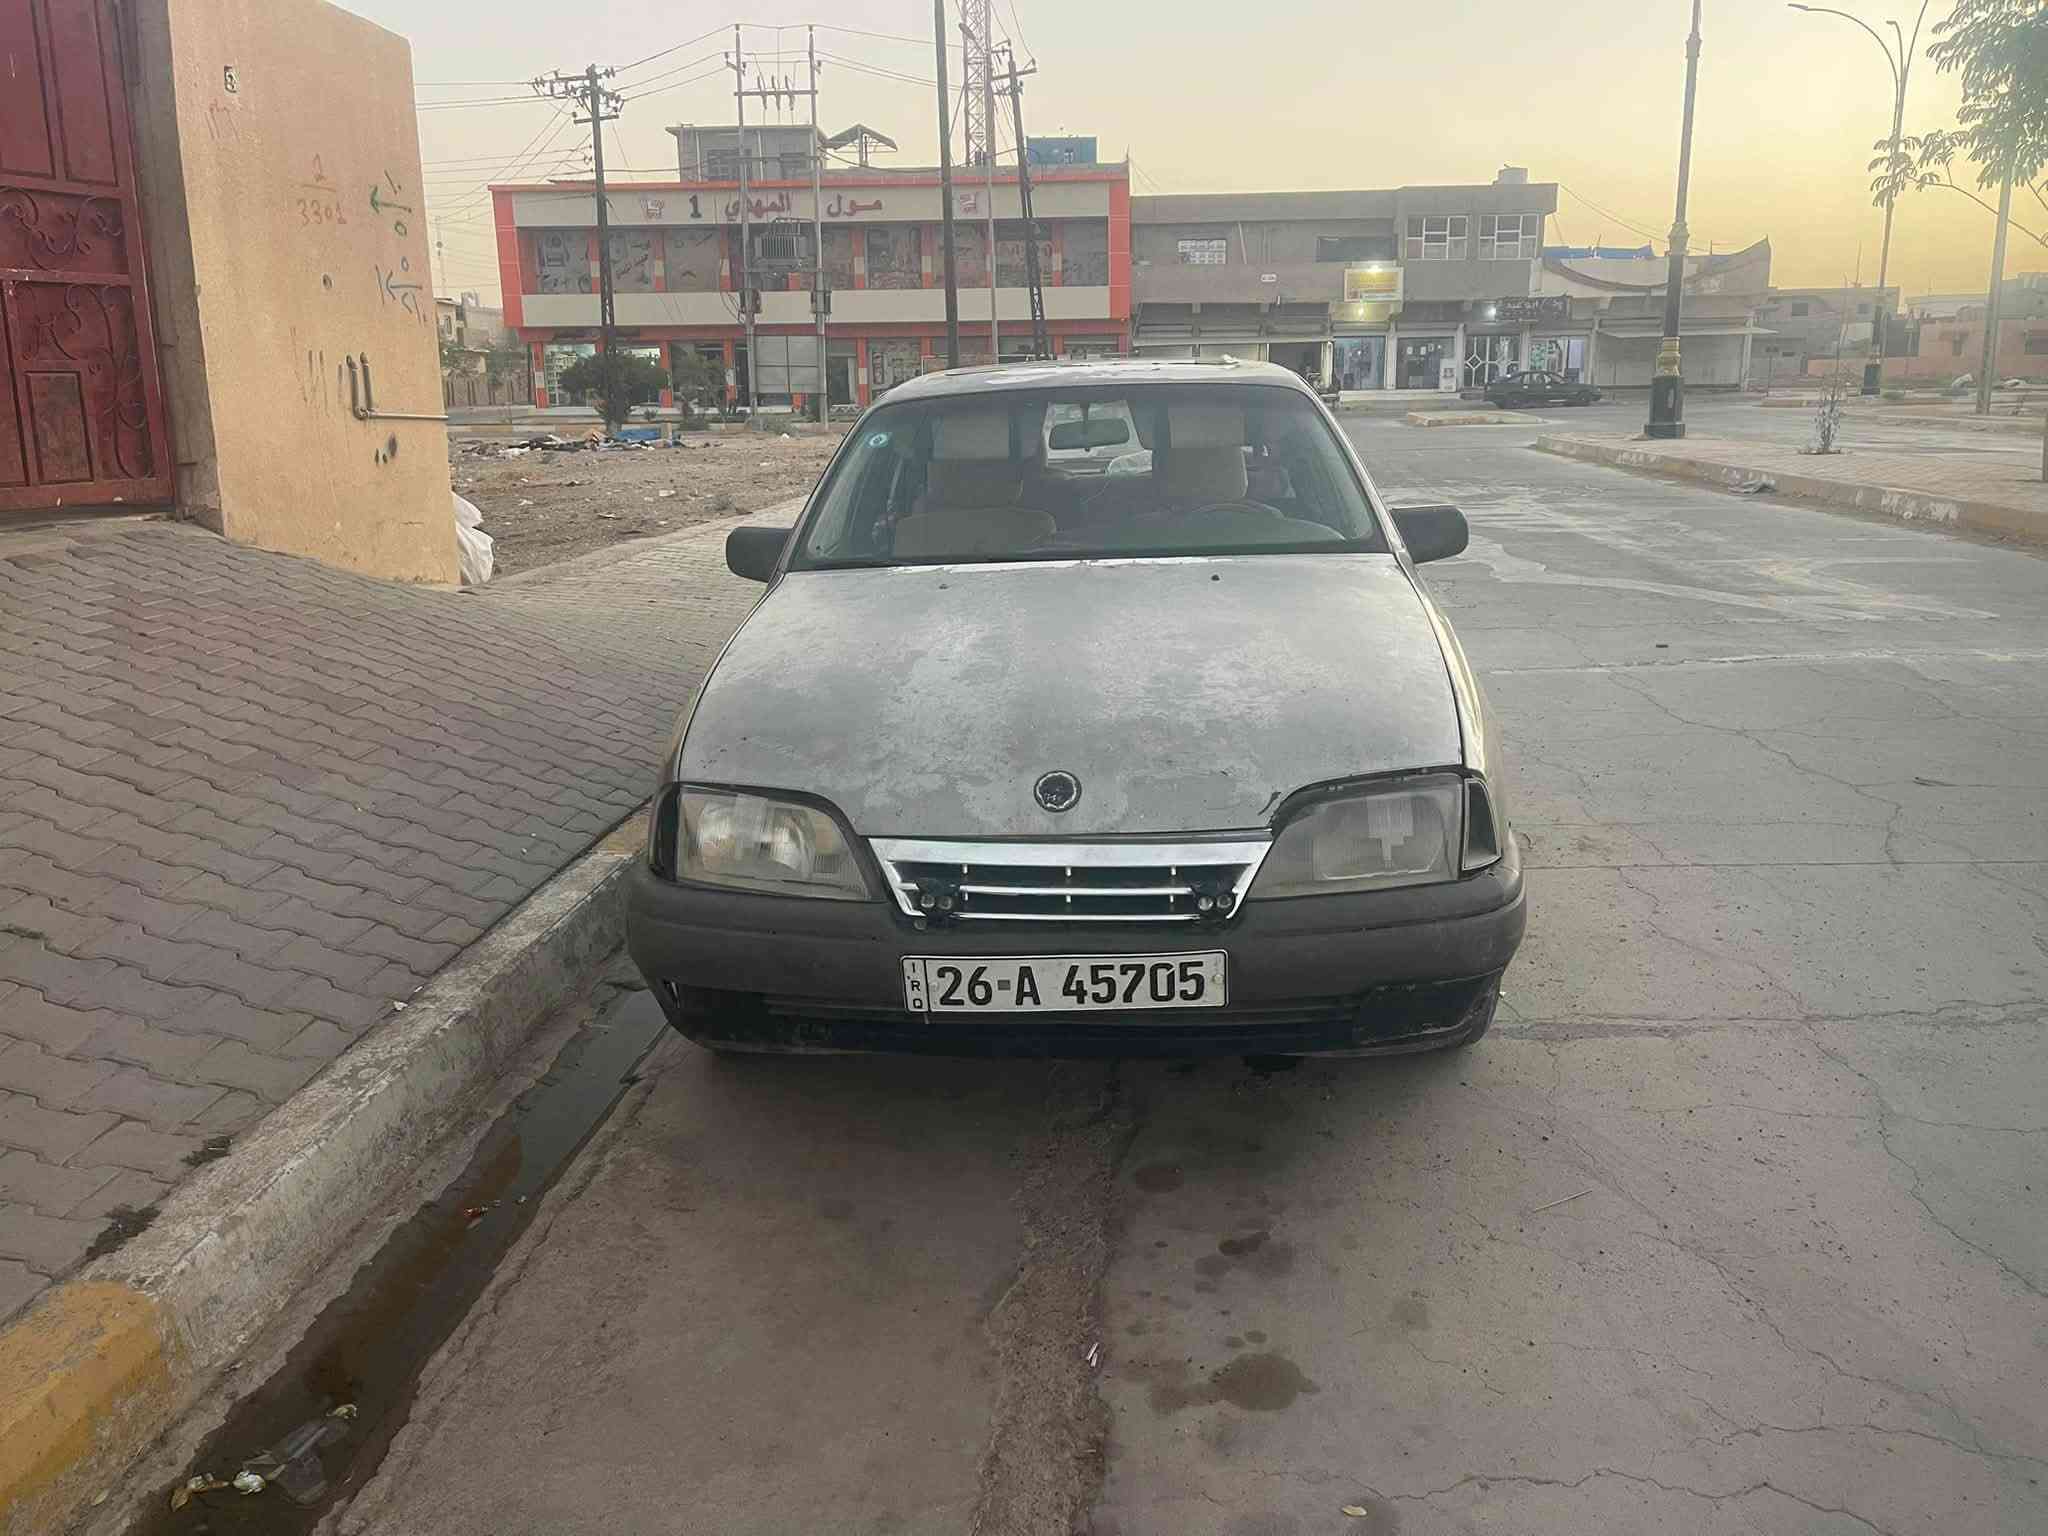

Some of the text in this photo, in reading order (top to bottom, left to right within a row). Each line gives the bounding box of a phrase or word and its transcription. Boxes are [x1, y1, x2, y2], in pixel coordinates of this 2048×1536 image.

[689, 195, 702, 219] 1
[826, 193, 883, 218] مول
[910, 962, 924, 1010] IRQ
[1061, 960, 1206, 1006] 45705
